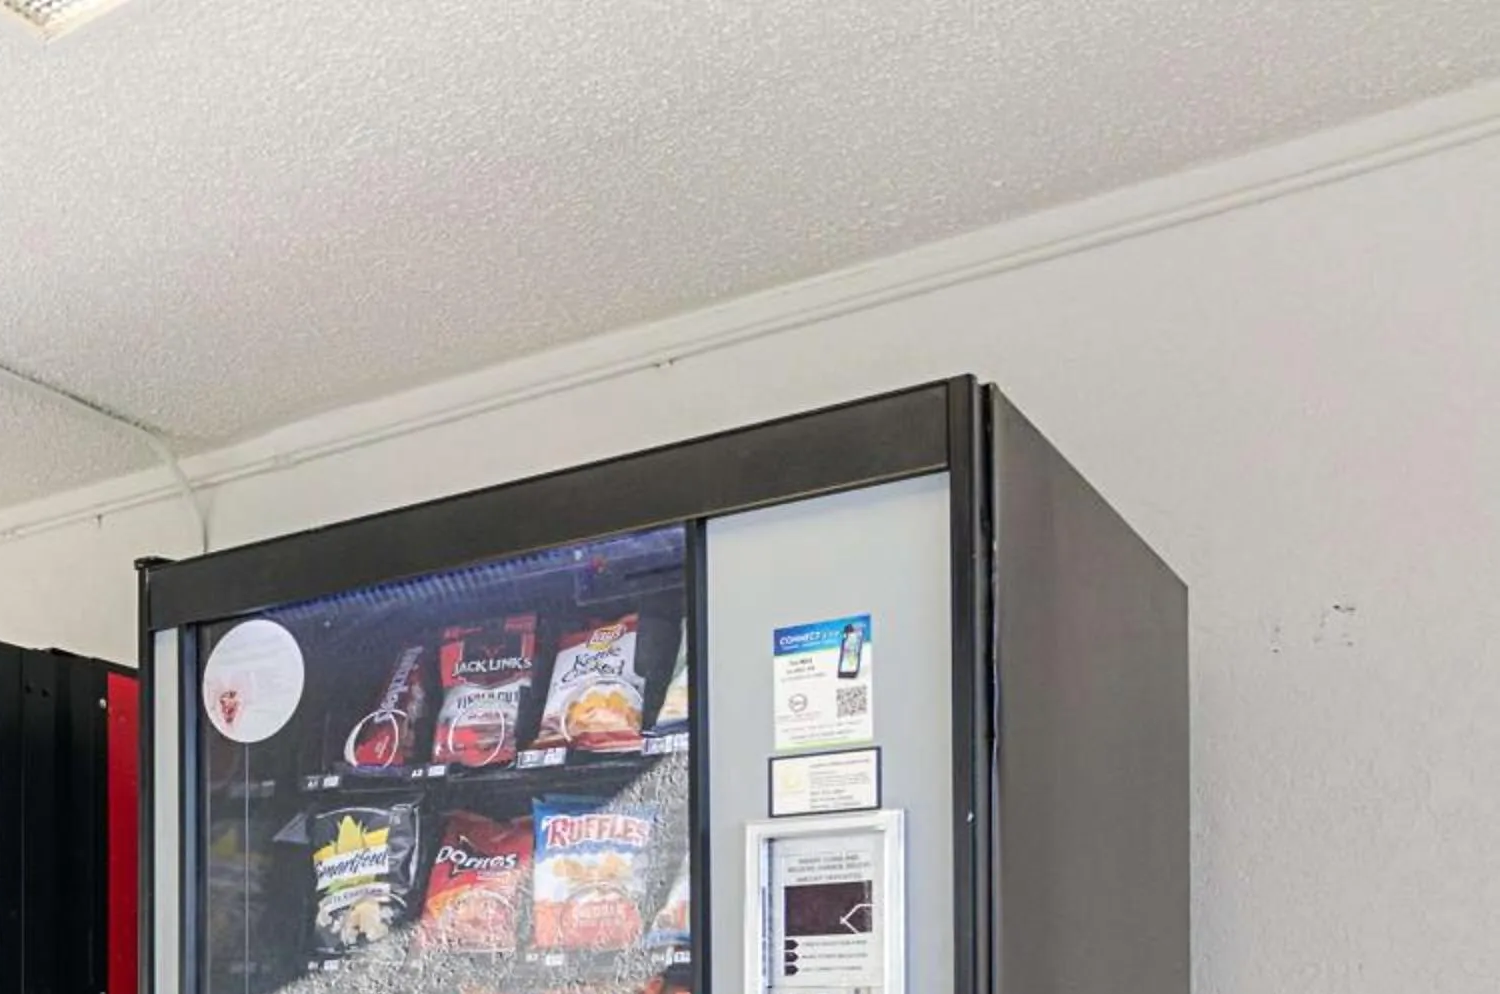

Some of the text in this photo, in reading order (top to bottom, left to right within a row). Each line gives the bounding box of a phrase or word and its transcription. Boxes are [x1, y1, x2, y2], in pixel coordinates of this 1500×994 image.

[453, 661, 486, 676] JACK
[543, 814, 650, 848] RUFFLES
[435, 845, 517, 870] Doritos
